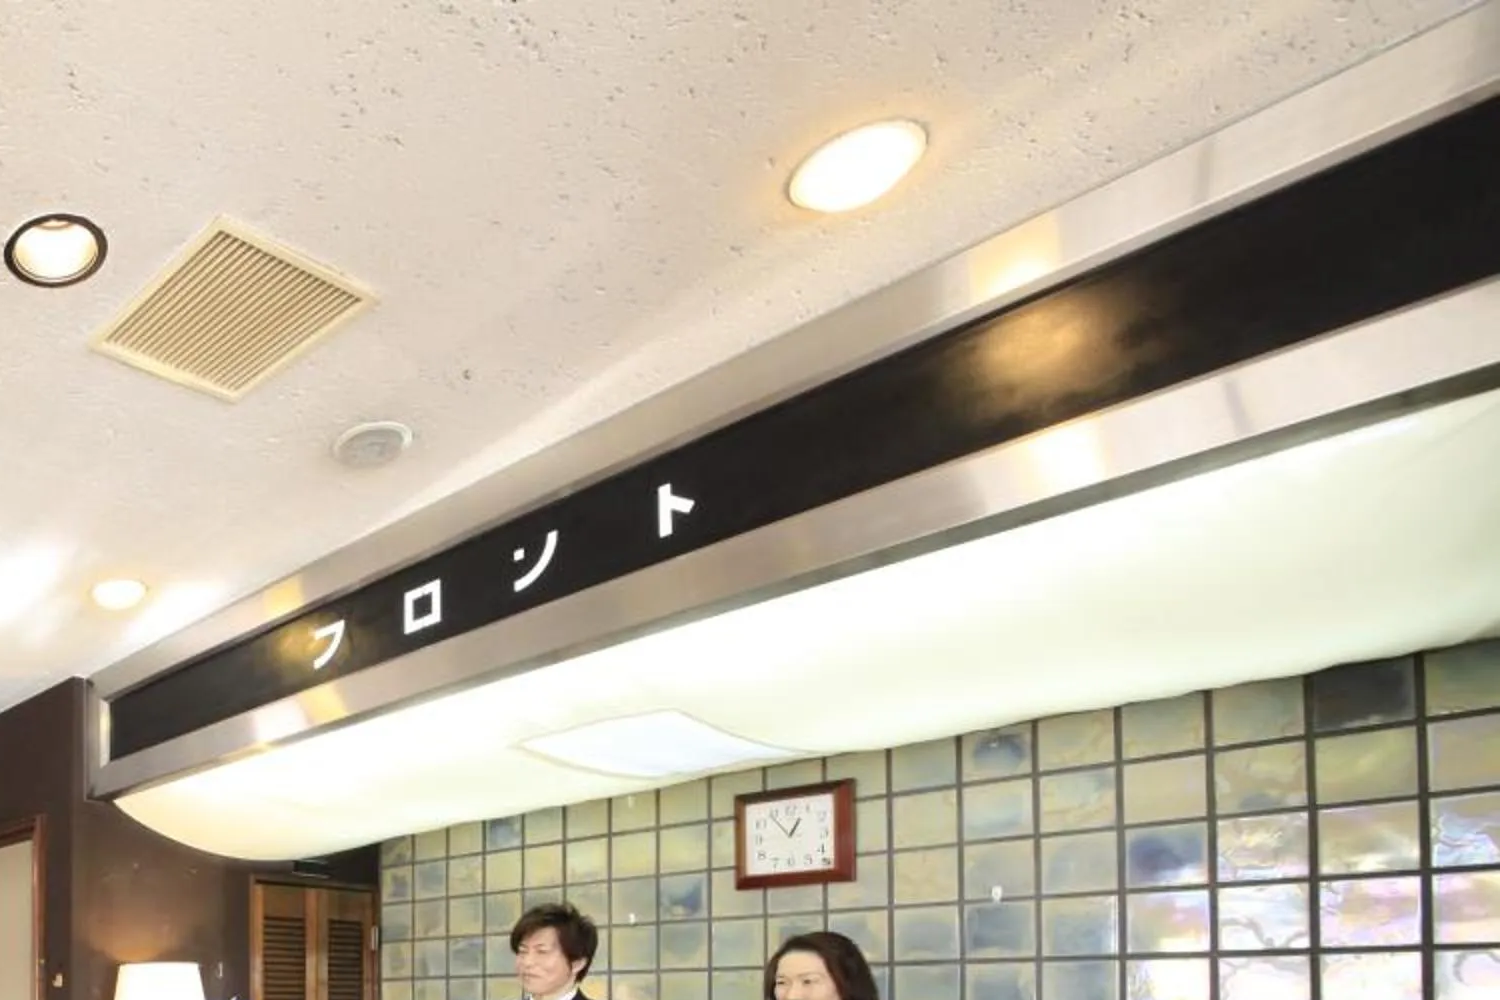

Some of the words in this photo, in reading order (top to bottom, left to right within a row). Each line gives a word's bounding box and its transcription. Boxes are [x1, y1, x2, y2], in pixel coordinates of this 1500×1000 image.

[313, 484, 695, 670] フロント
[757, 849, 767, 861] 8
[816, 843, 826, 855] 4
